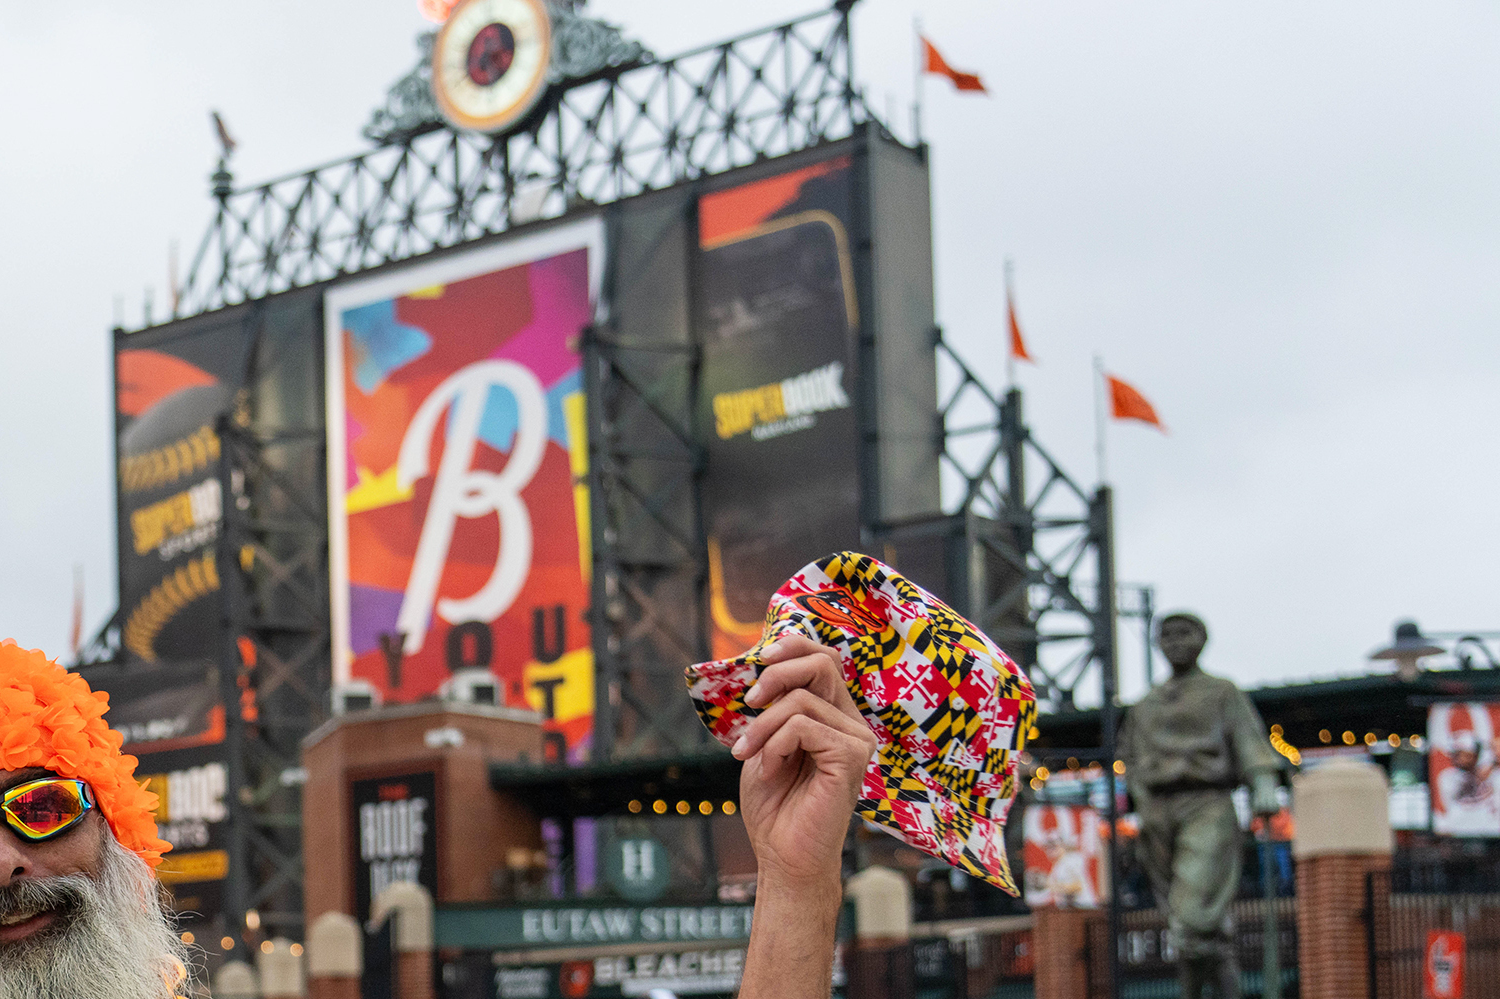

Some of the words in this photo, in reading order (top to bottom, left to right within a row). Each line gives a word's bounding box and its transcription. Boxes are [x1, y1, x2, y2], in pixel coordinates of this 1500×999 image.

[396, 359, 550, 656] B
[522, 908, 636, 943] EUTAW
[592, 948, 744, 986] BLEACHE
